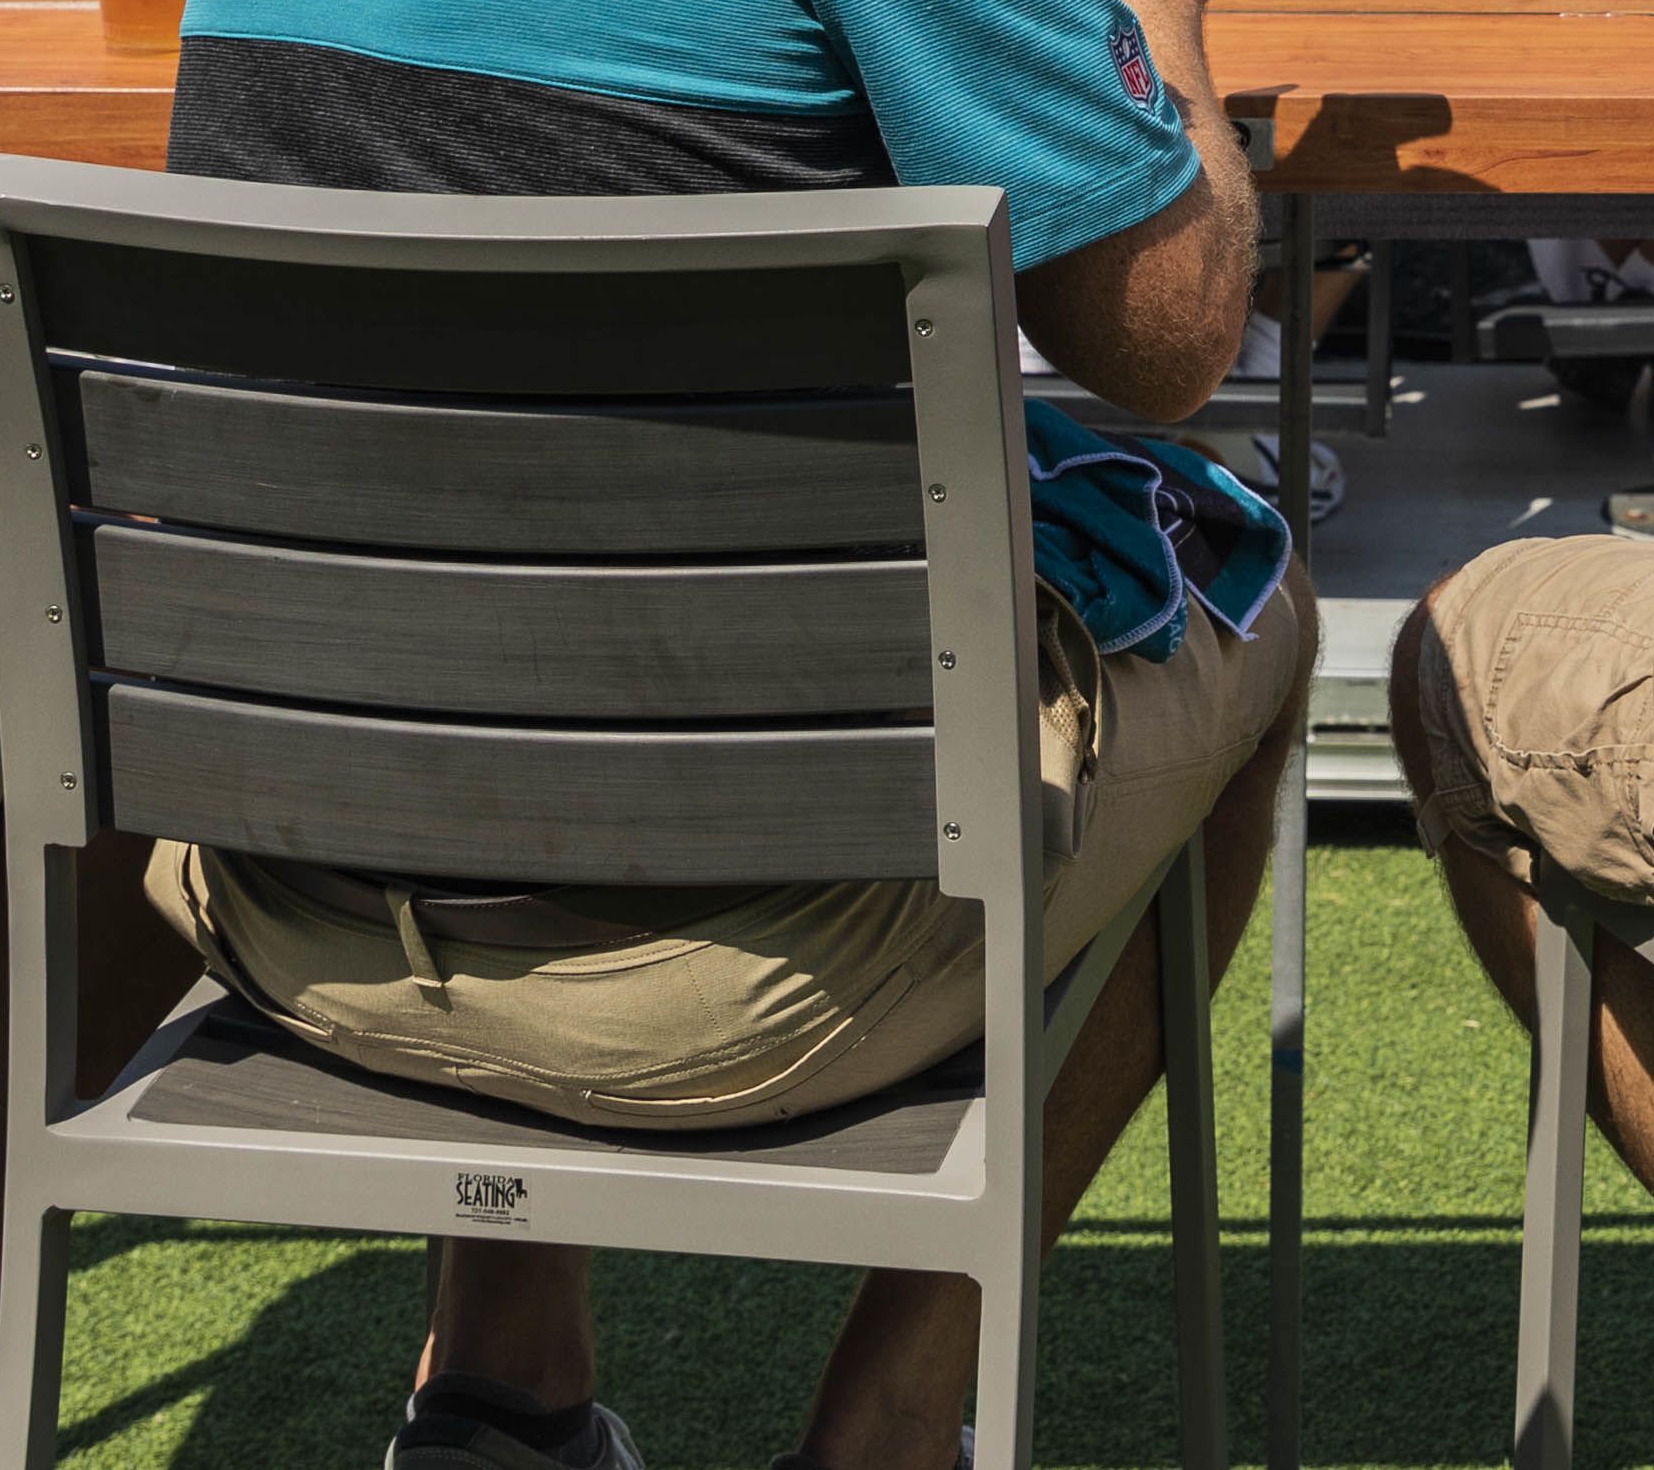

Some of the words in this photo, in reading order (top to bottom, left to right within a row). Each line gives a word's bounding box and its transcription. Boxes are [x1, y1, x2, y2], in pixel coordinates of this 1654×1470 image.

[1121, 62, 1151, 97] NFL
[457, 1172, 515, 1184] FLORIDA
[456, 1180, 516, 1209] SEATING
